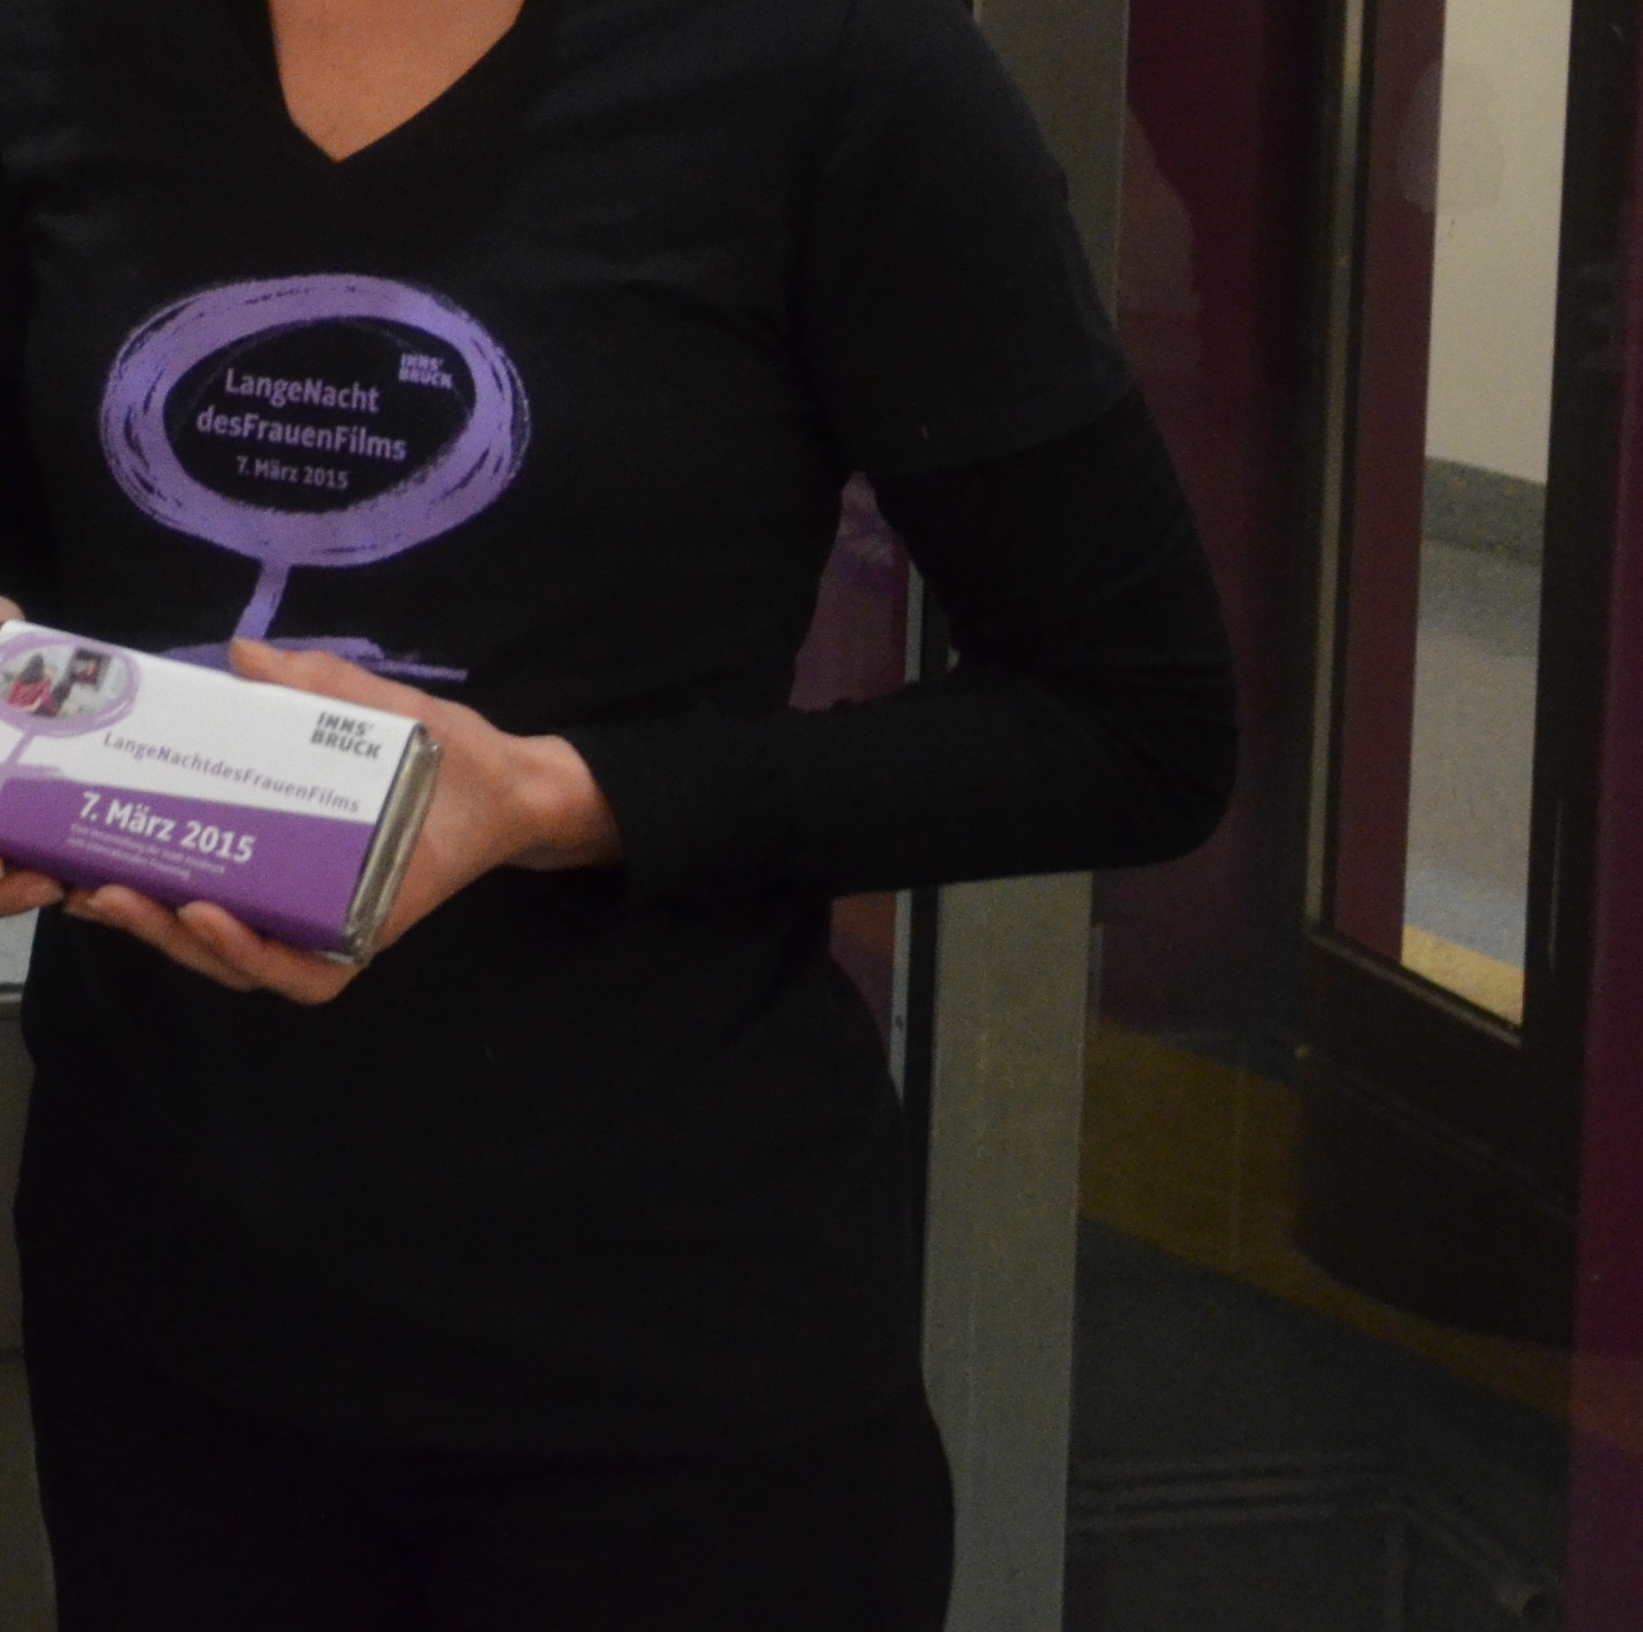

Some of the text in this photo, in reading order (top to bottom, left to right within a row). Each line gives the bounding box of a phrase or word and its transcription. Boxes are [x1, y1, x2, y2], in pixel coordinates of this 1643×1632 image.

[225, 367, 381, 414] LangeNacht
[398, 368, 454, 390] BRUCK
[196, 404, 409, 461] desFrauenFilms
[254, 458, 299, 484] März
[302, 465, 350, 490] 2015
[310, 729, 383, 760] BRUCK
[103, 730, 361, 814] LangeNachtdesFrauenFilms
[79, 790, 102, 822] 7.
[105, 798, 177, 843] März
[180, 819, 257, 864] 2015
